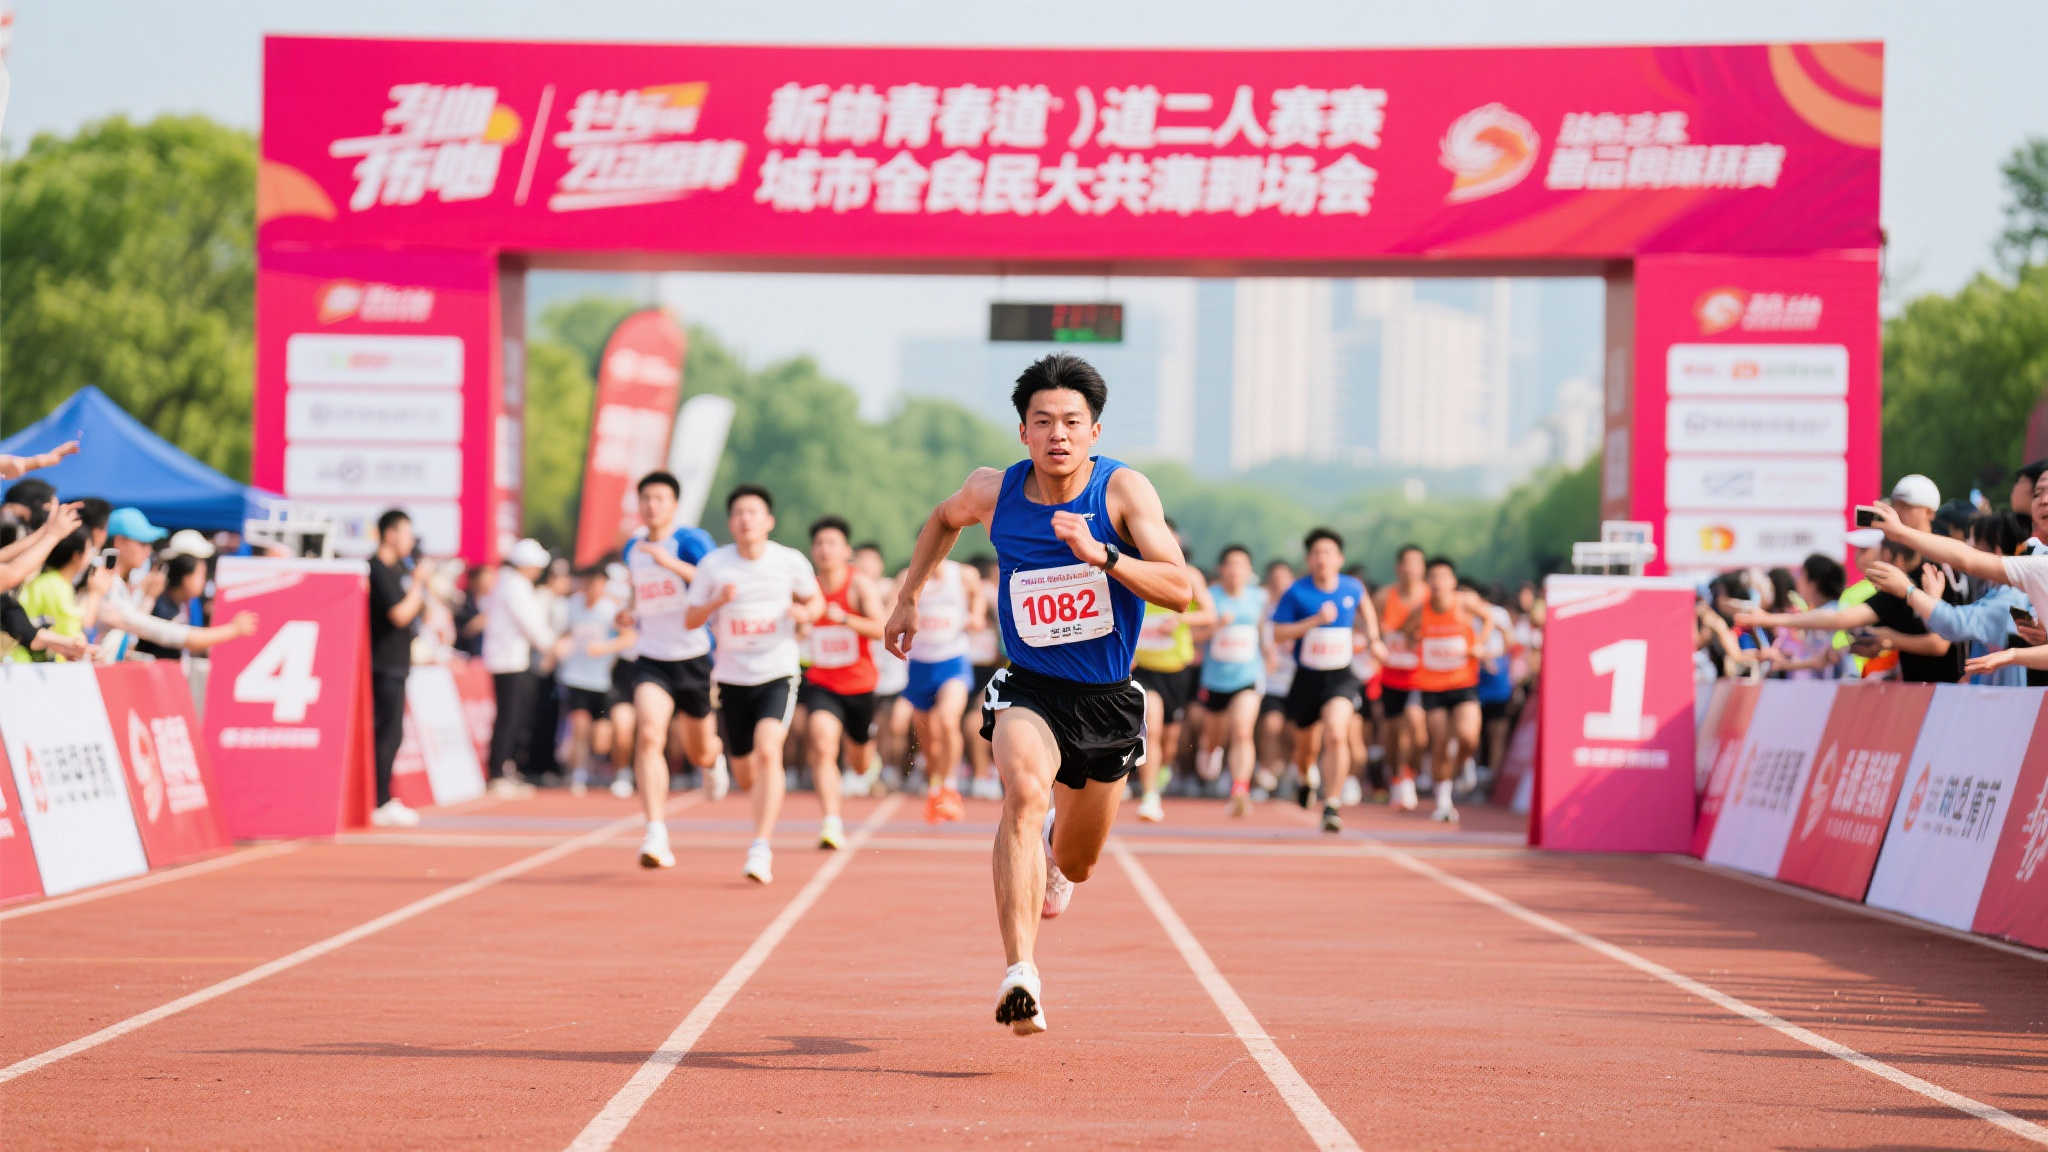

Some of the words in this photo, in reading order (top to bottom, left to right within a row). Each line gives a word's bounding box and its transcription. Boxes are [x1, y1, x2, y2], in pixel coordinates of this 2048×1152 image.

[1022, 589, 1099, 626] 1082
[234, 620, 321, 723] 4
[1583, 639, 1656, 741] 1
